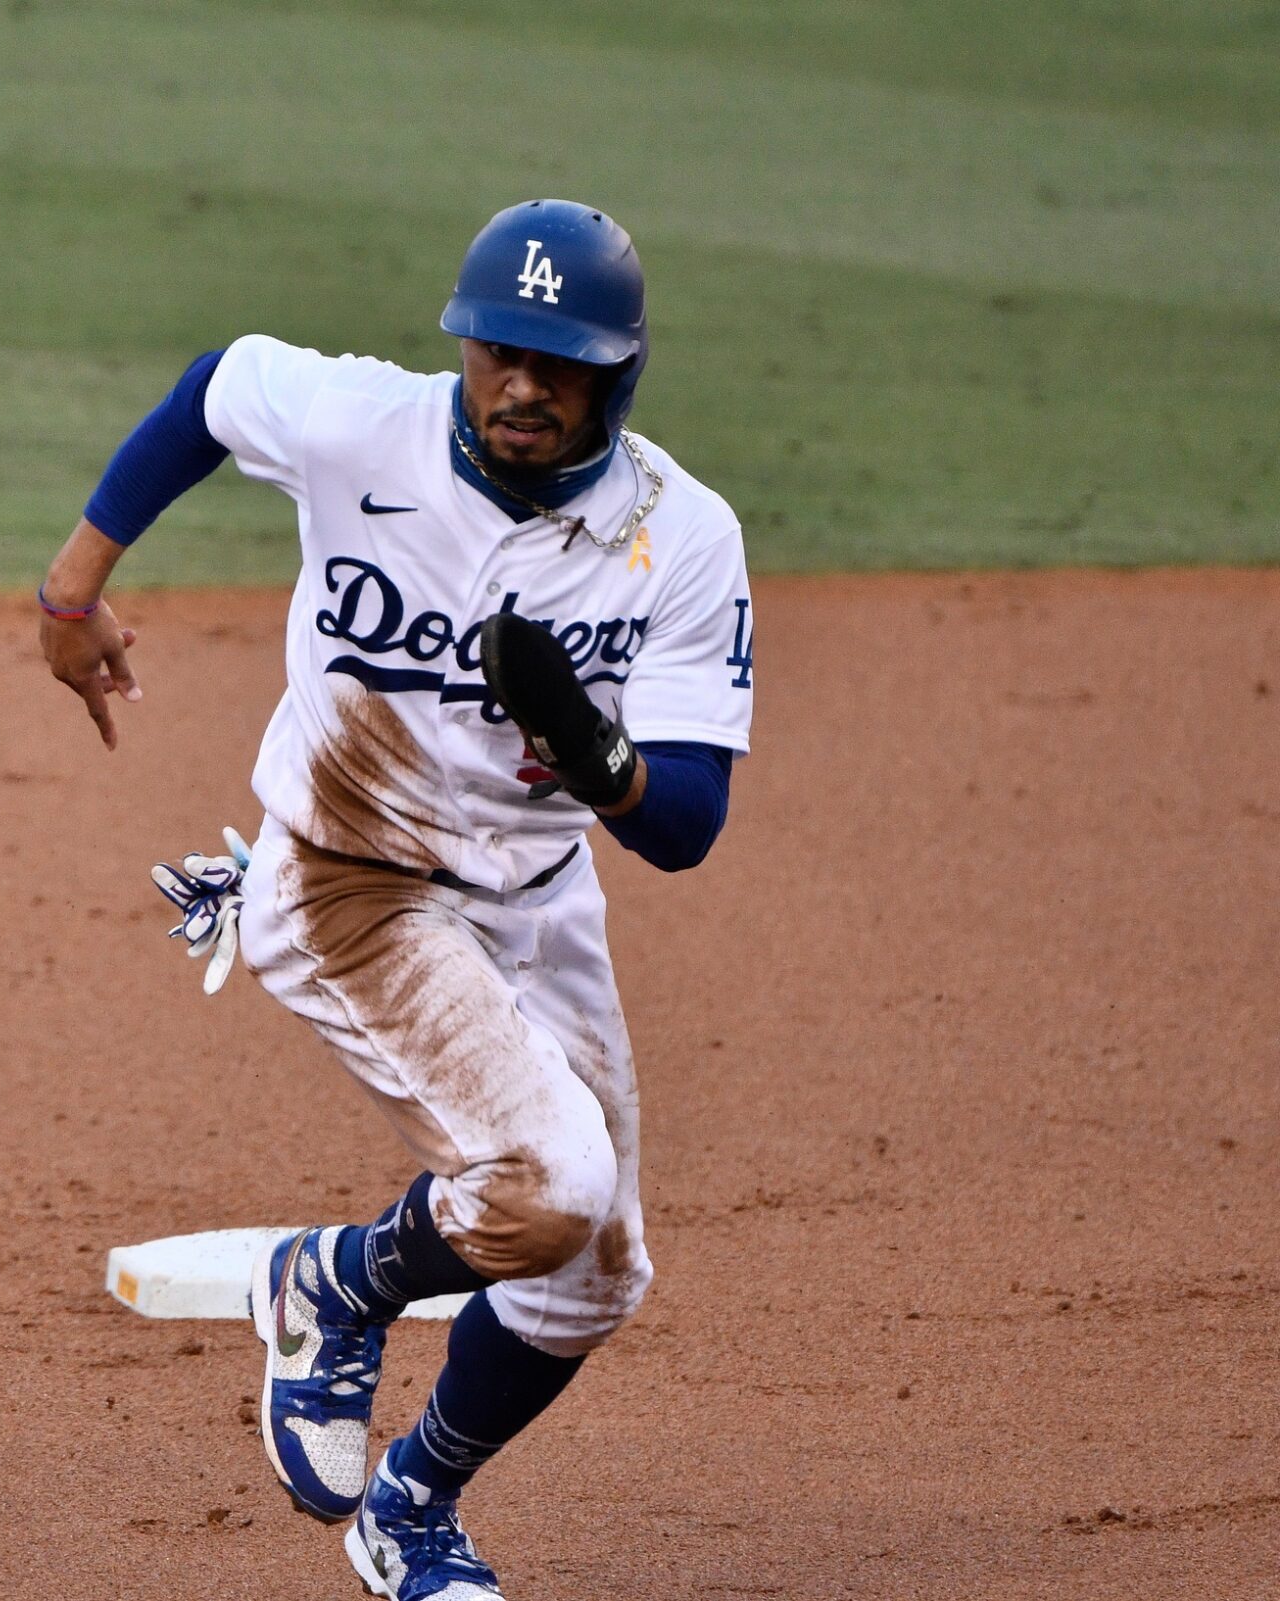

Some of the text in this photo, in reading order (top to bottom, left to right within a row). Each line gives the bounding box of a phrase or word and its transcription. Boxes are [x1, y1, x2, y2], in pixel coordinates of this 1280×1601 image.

[517, 239, 563, 304] LA
[316, 556, 650, 724] Doders
[606, 737, 629, 774] 50
